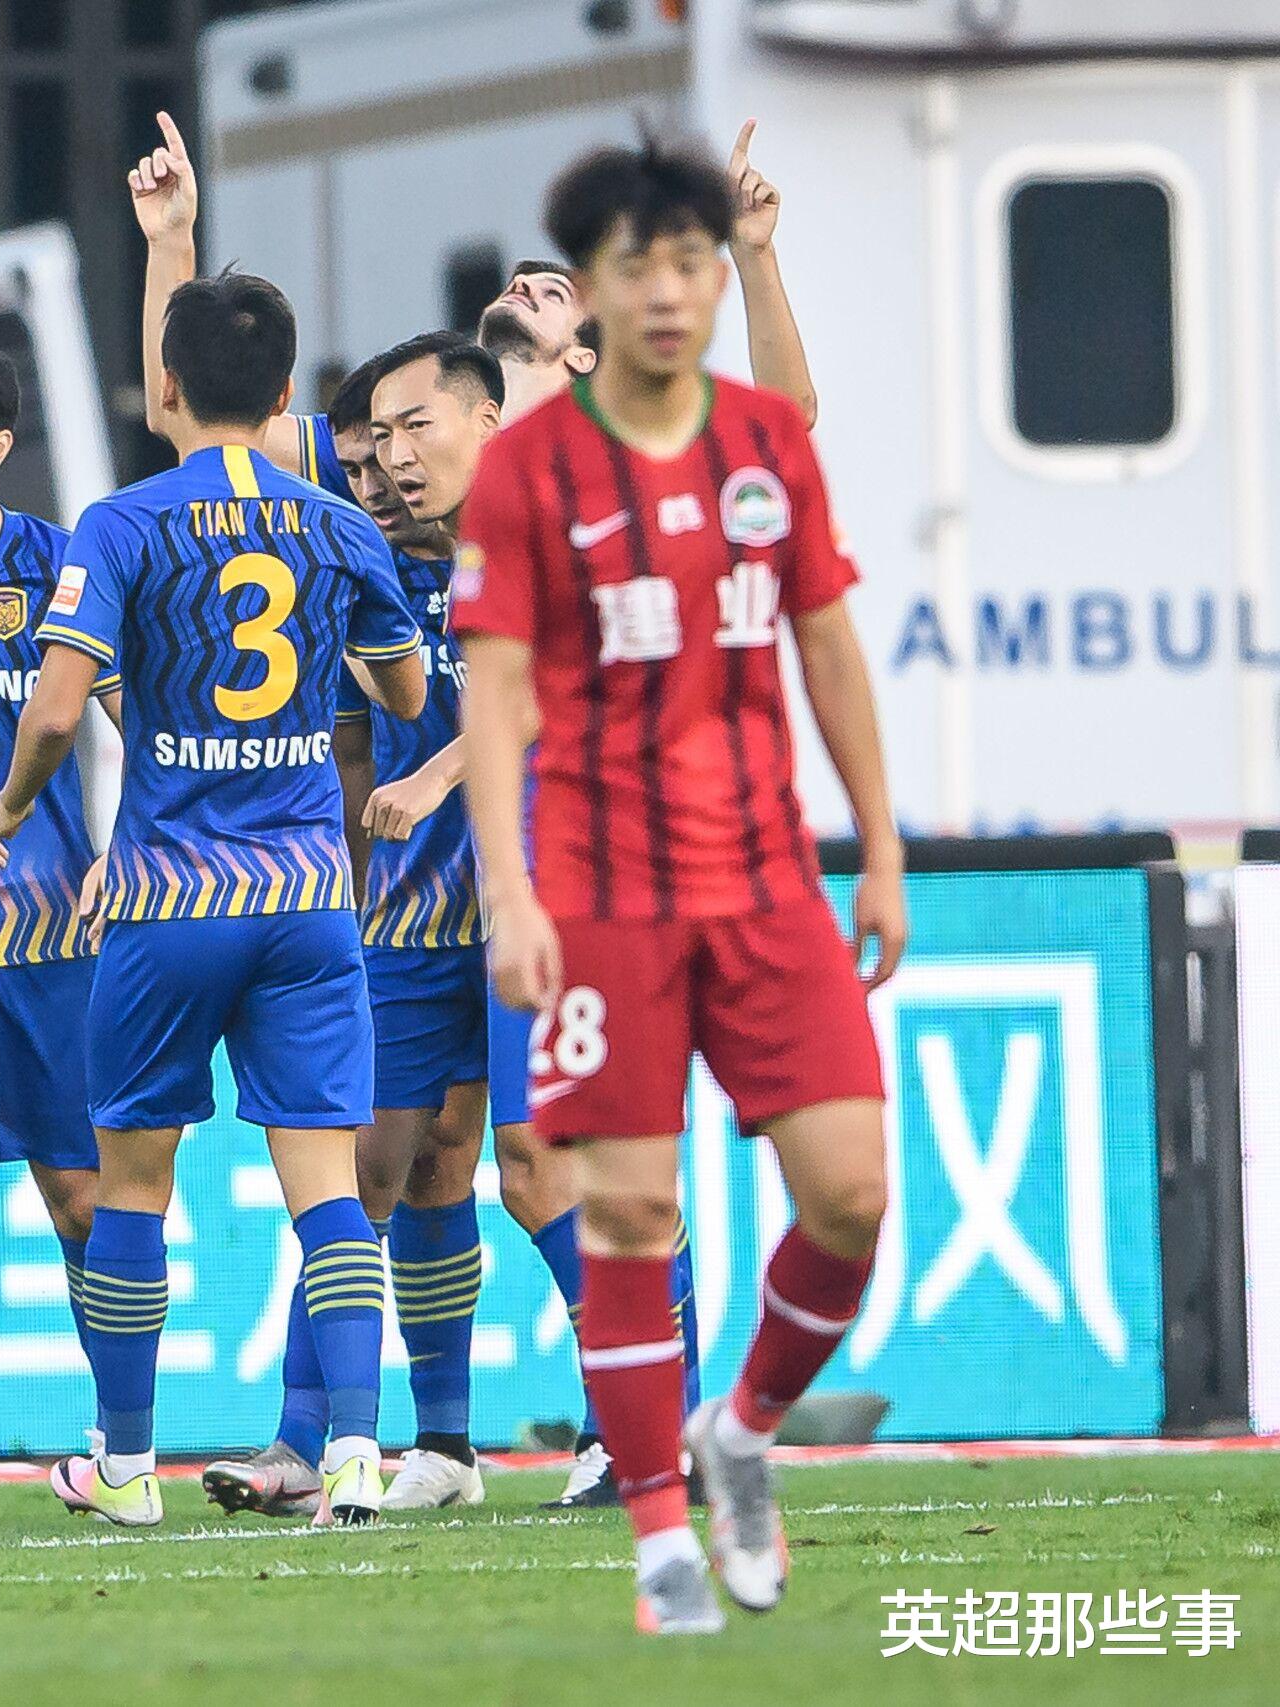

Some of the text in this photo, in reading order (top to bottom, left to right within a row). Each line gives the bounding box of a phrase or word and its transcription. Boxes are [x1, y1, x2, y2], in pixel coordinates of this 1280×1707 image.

[190, 501, 310, 537] TIAN Y.N.
[214, 552, 298, 721] 3
[154, 732, 331, 770] SAMSUNG
